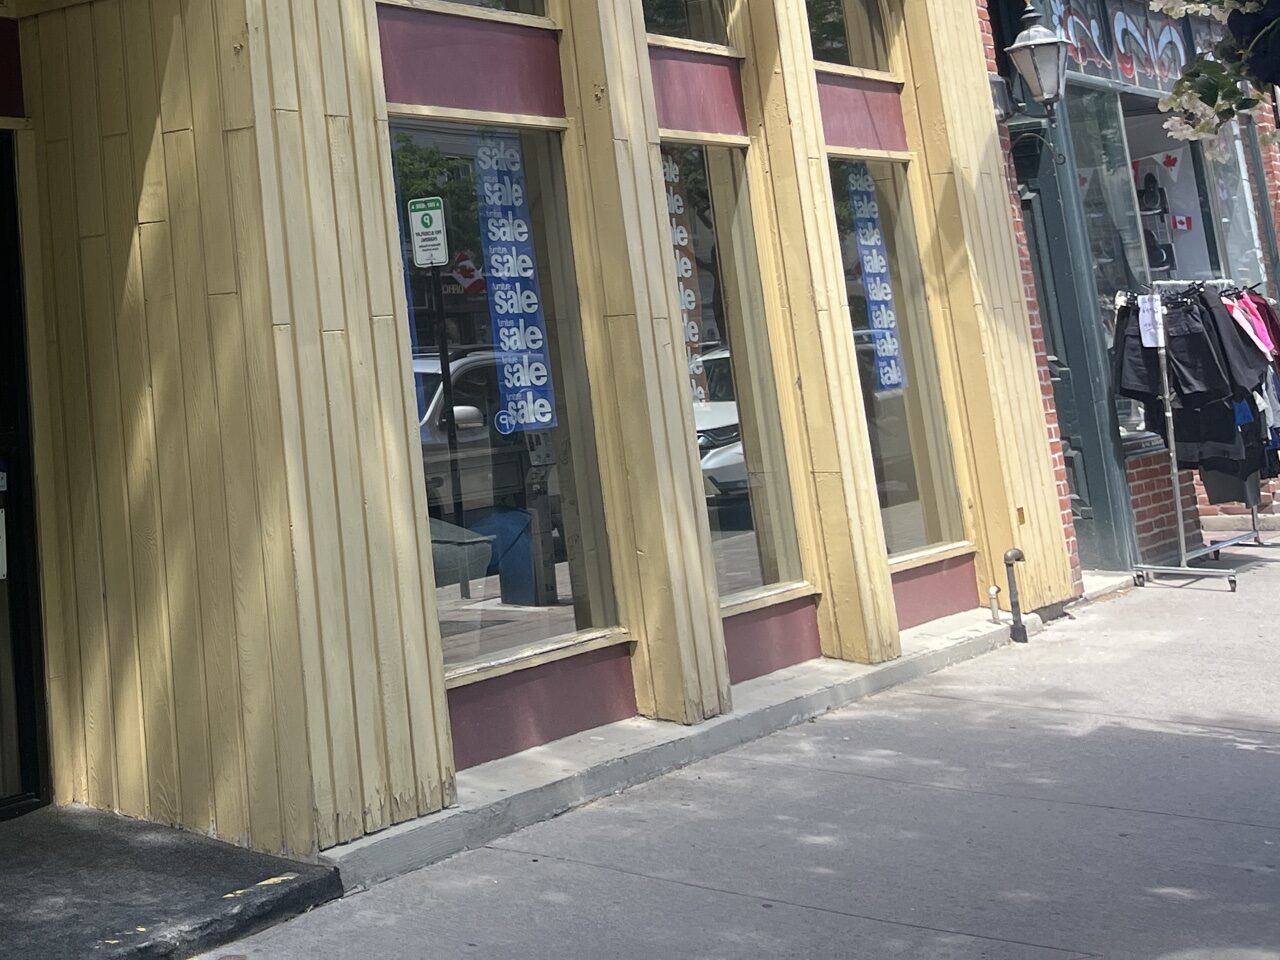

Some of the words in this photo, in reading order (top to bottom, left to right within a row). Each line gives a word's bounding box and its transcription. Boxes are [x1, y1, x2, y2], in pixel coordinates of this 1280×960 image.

[477, 142, 521, 171] sale
[483, 176, 523, 207] sale
[848, 168, 875, 192] sale
[854, 195, 878, 219] sale
[488, 211, 528, 242] sale
[670, 218, 688, 246] le
[859, 222, 881, 246] sale
[490, 246, 534, 278] sale
[674, 250, 692, 278] le
[863, 249, 886, 273] sale
[494, 283, 538, 314] sale
[679, 281, 696, 310] le
[867, 277, 892, 301] sale
[683, 313, 699, 342] le
[871, 304, 895, 329] sale
[499, 319, 543, 351] sale
[876, 332, 898, 357] sale
[504, 355, 547, 388] sale
[687, 346, 703, 374] le
[880, 359, 902, 385] sale
[691, 379, 705, 402] le
[507, 391, 552, 424] sale
